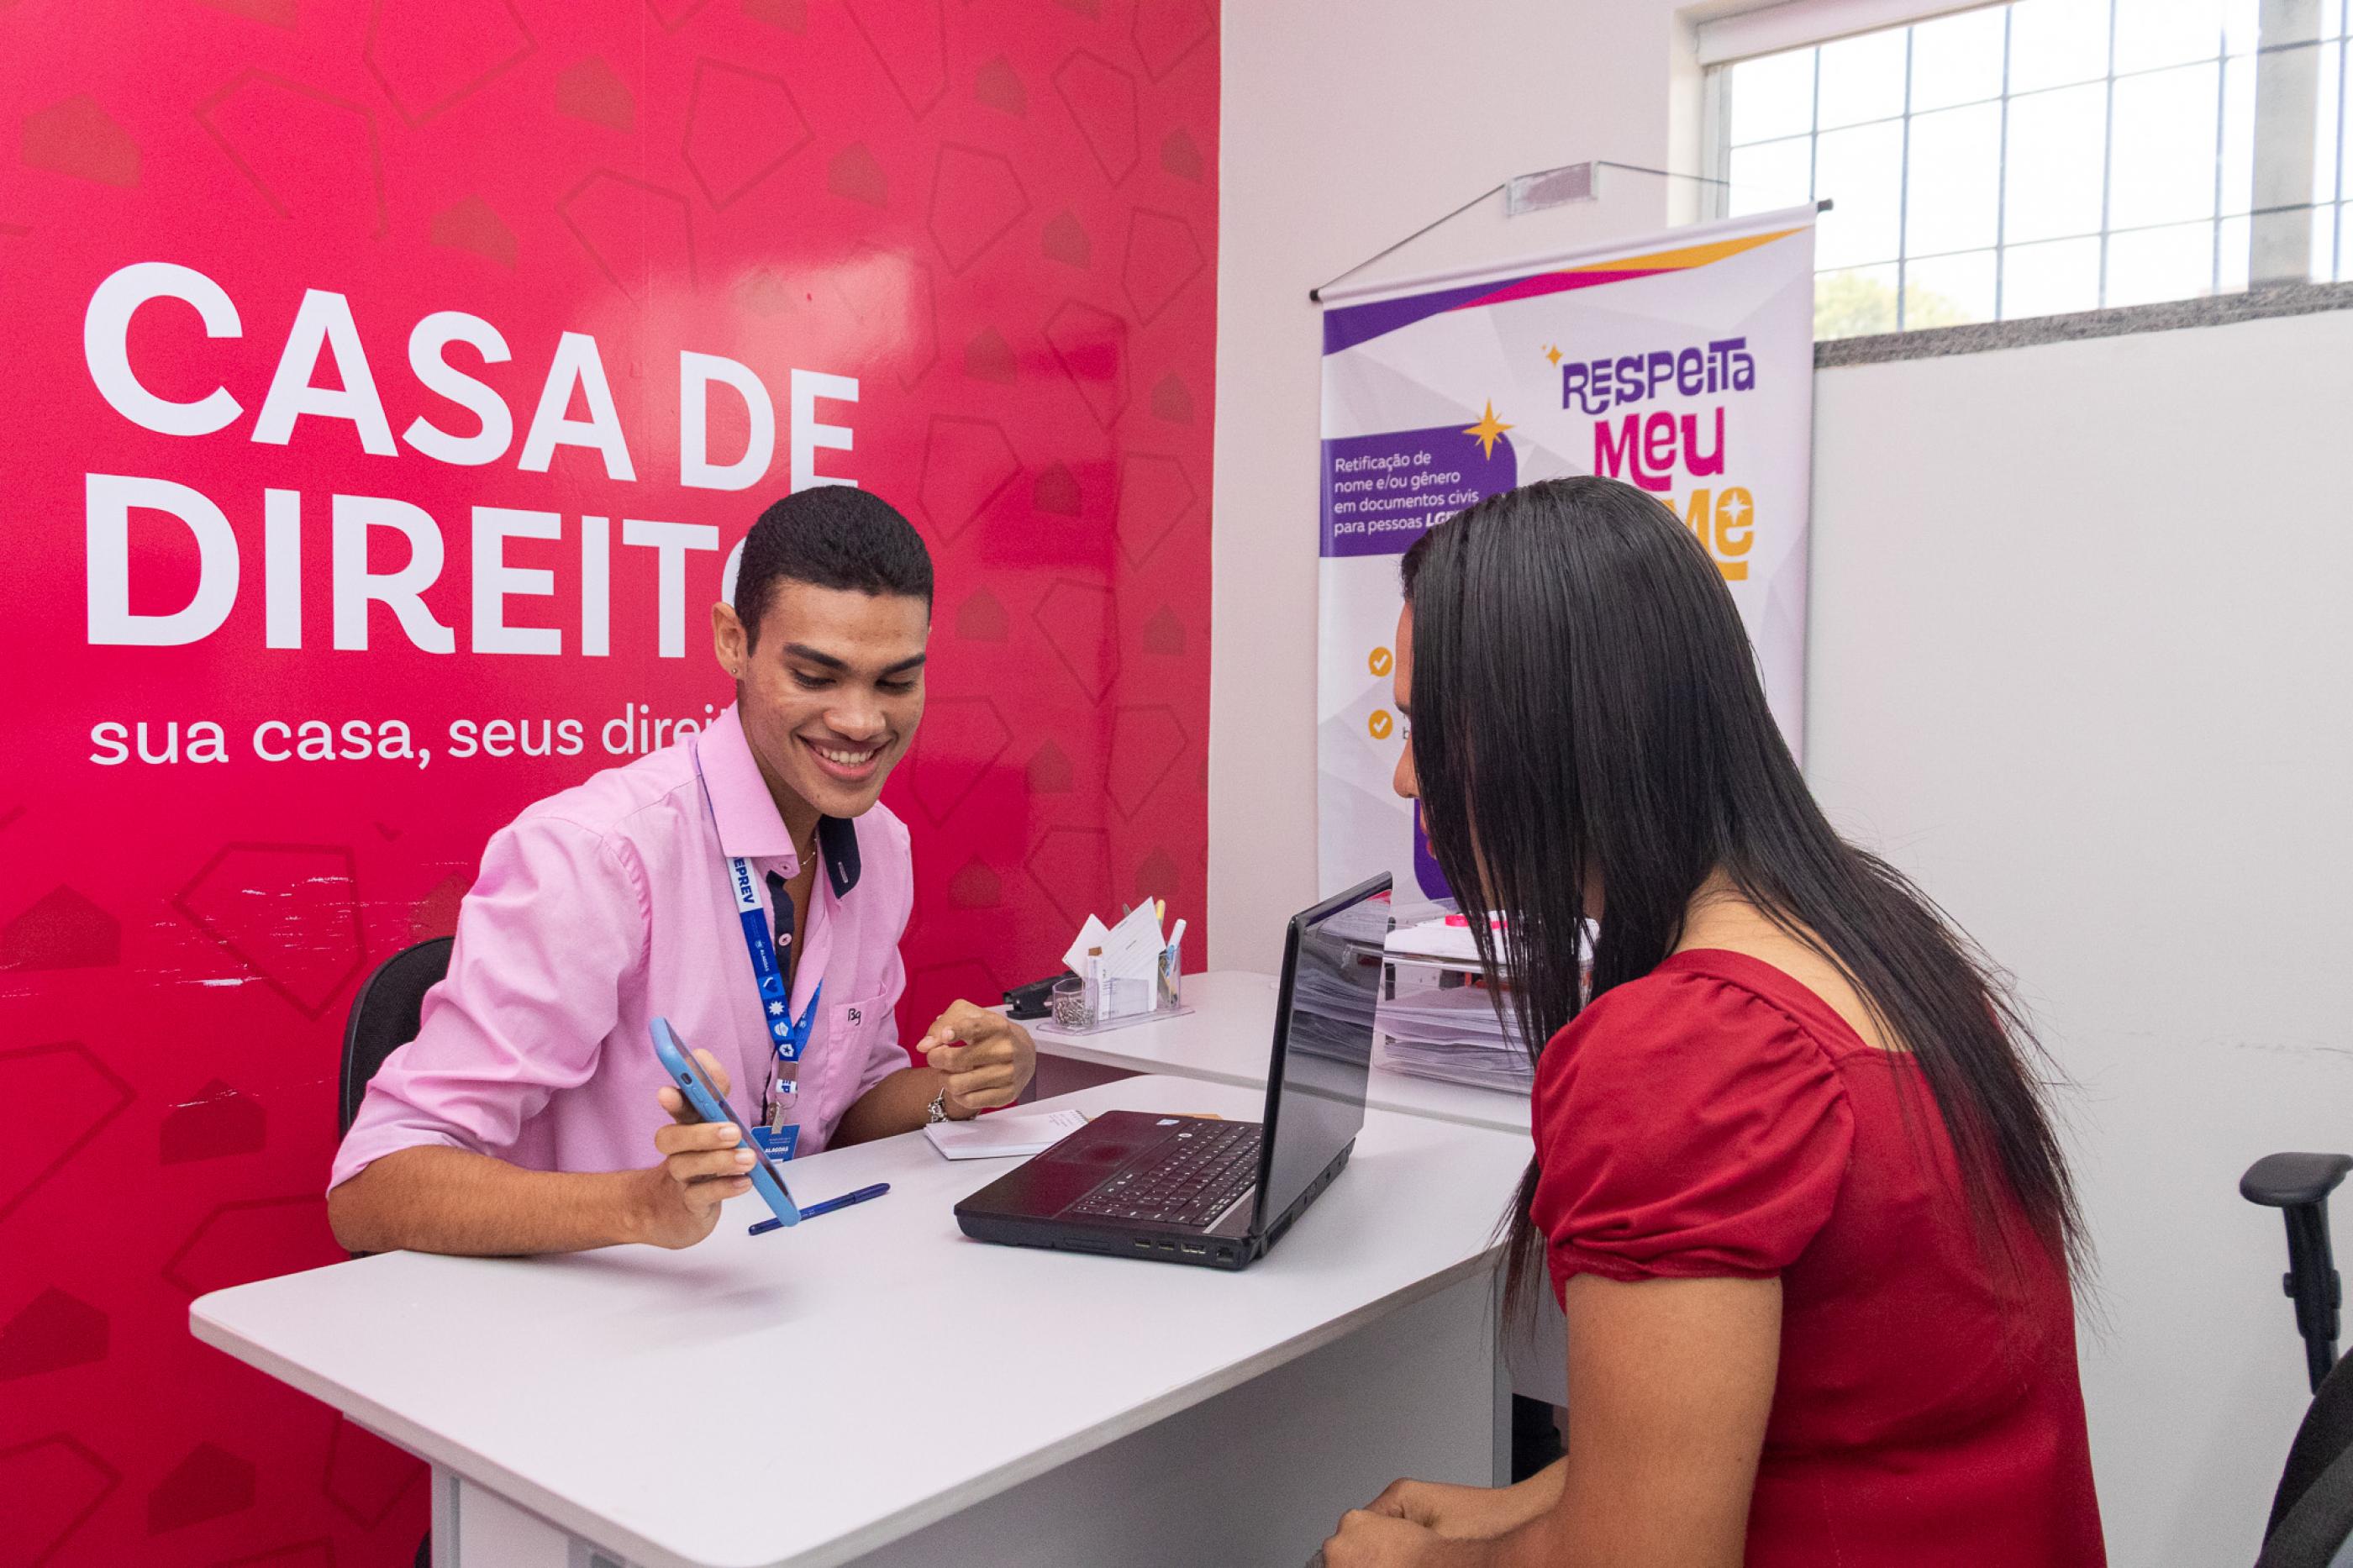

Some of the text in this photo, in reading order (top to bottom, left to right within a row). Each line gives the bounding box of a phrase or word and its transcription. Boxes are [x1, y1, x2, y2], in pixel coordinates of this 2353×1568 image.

[85, 262, 861, 494] CASA DE
[1335, 450, 1432, 472] Retificação de
[1334, 471, 1461, 492] nome e/ou gênero
[1334, 489, 1480, 513] em documentos civis
[1334, 520, 1366, 537] para
[1368, 516, 1423, 535] pessoas
[86, 472, 747, 656] DIREIT
[90, 702, 727, 770] sua casa, seus dire
[734, 857, 755, 904] EPREV
